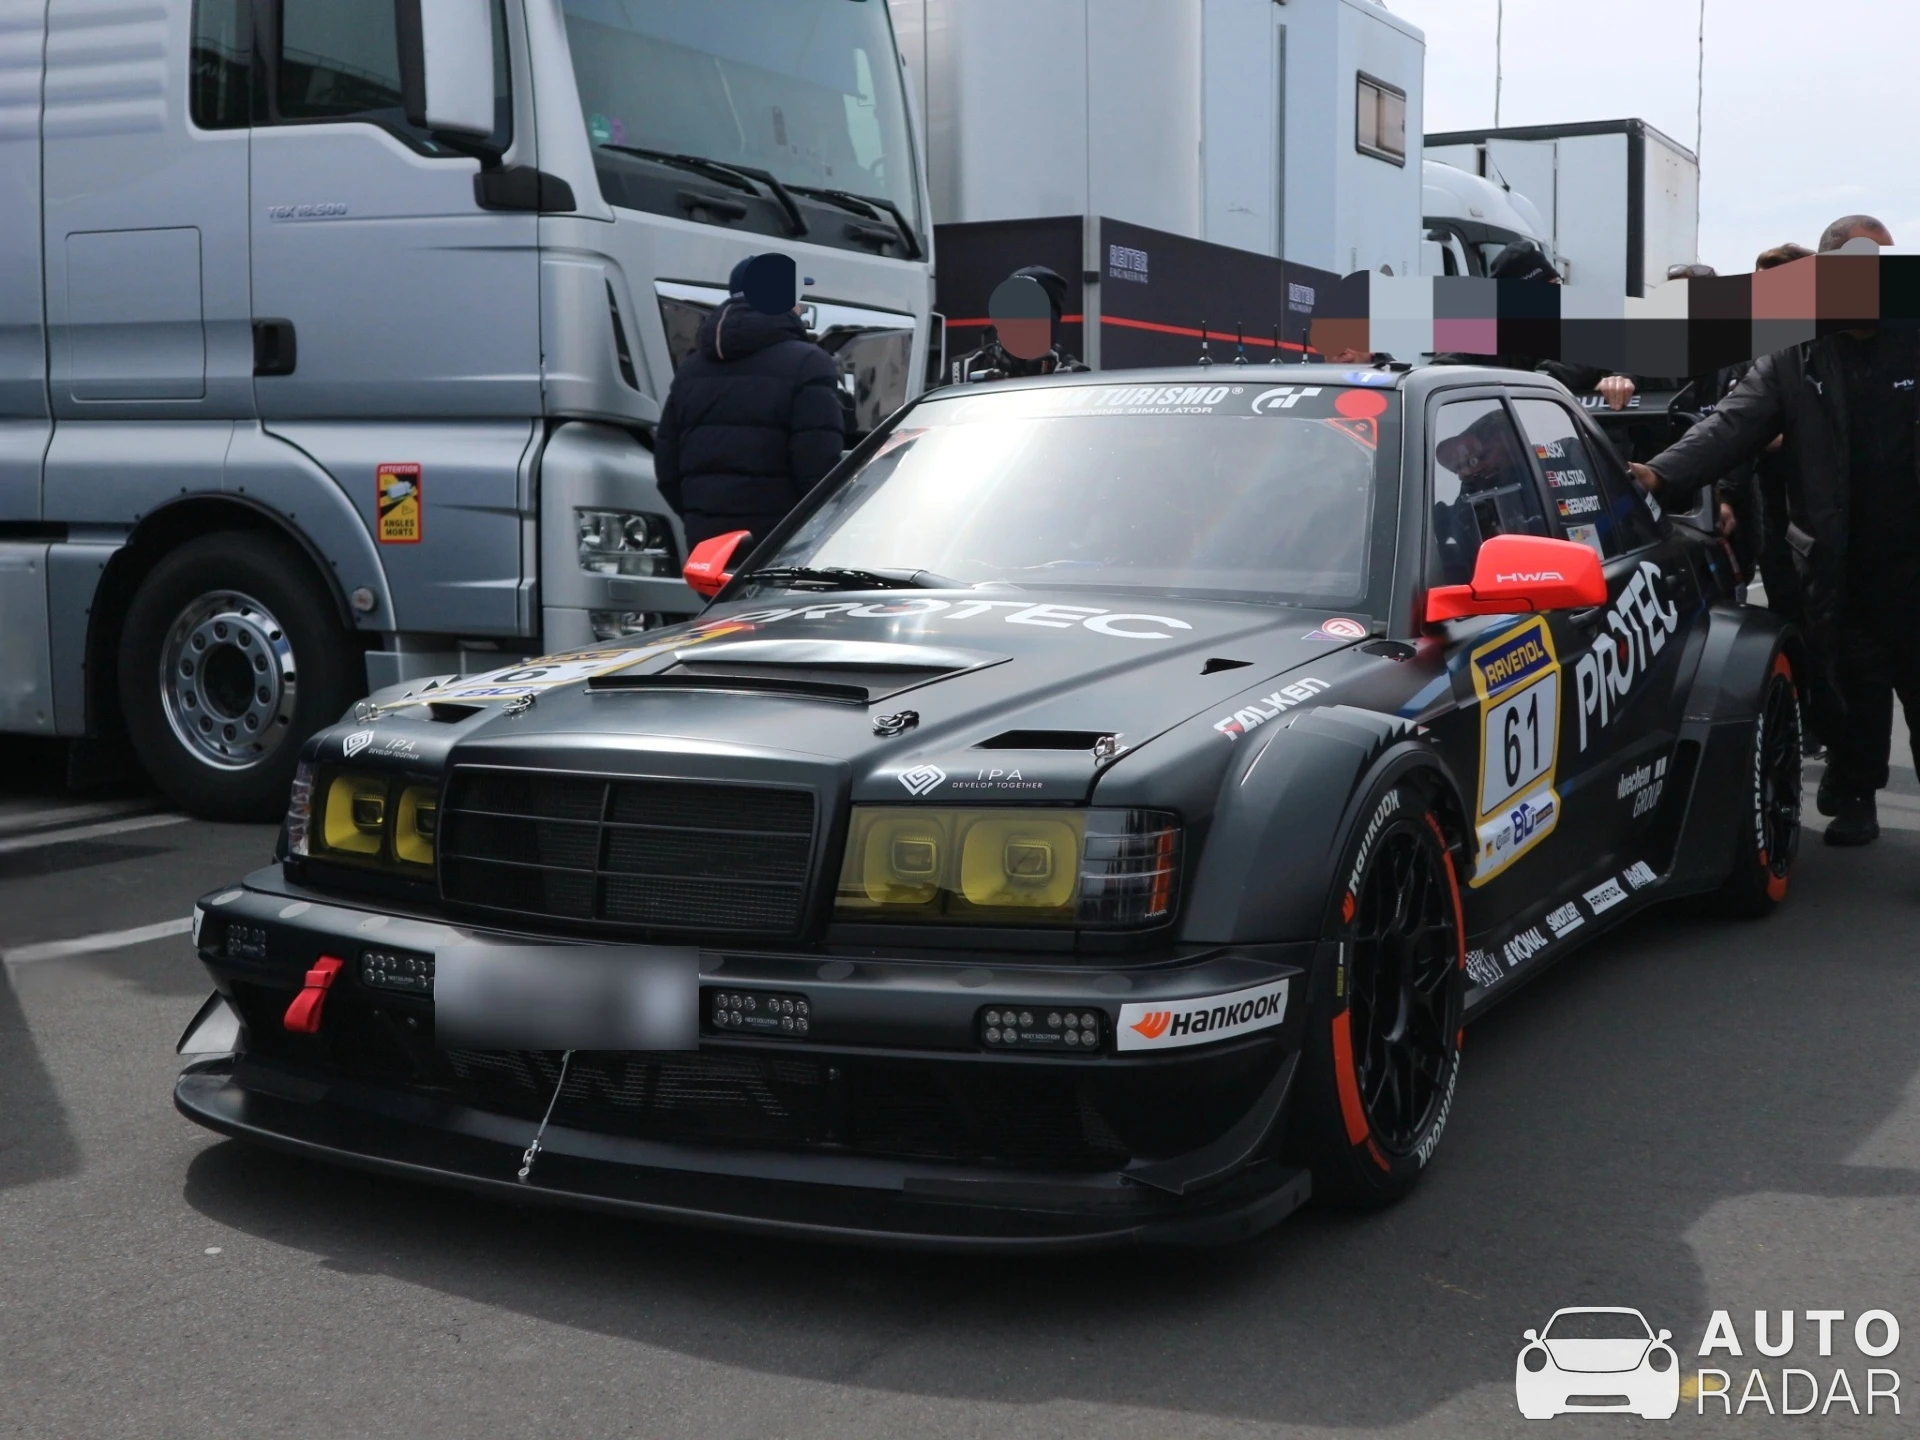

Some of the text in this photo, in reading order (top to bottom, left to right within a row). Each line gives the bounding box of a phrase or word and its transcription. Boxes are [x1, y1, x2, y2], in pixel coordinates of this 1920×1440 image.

[1109, 245, 1149, 272] REITER
[1127, 407, 1213, 415] SIMULATOR
[1544, 442, 1566, 459] ASCH
[380, 465, 419, 474] ATTENTION
[1555, 469, 1587, 487] HOLSTAD
[1565, 495, 1601, 515] GEBHARDT
[384, 519, 415, 528] ANGLES
[385, 528, 414, 537] MORTS
[1496, 571, 1564, 583] HWA
[1484, 639, 1545, 687] RAVENOL
[1575, 560, 1678, 753] PROTEC
[1213, 677, 1332, 742] FALKEN
[385, 738, 417, 752] IPA
[1504, 691, 1539, 788] 61
[367, 747, 420, 761] DEVELOP TOGETHER
[976, 768, 1024, 781] IPA
[996, 782, 1044, 790] TOGETHER
[1632, 779, 1664, 819] GROUP
[1589, 885, 1622, 908] RAVENOL
[1508, 926, 1549, 962] RONAL
